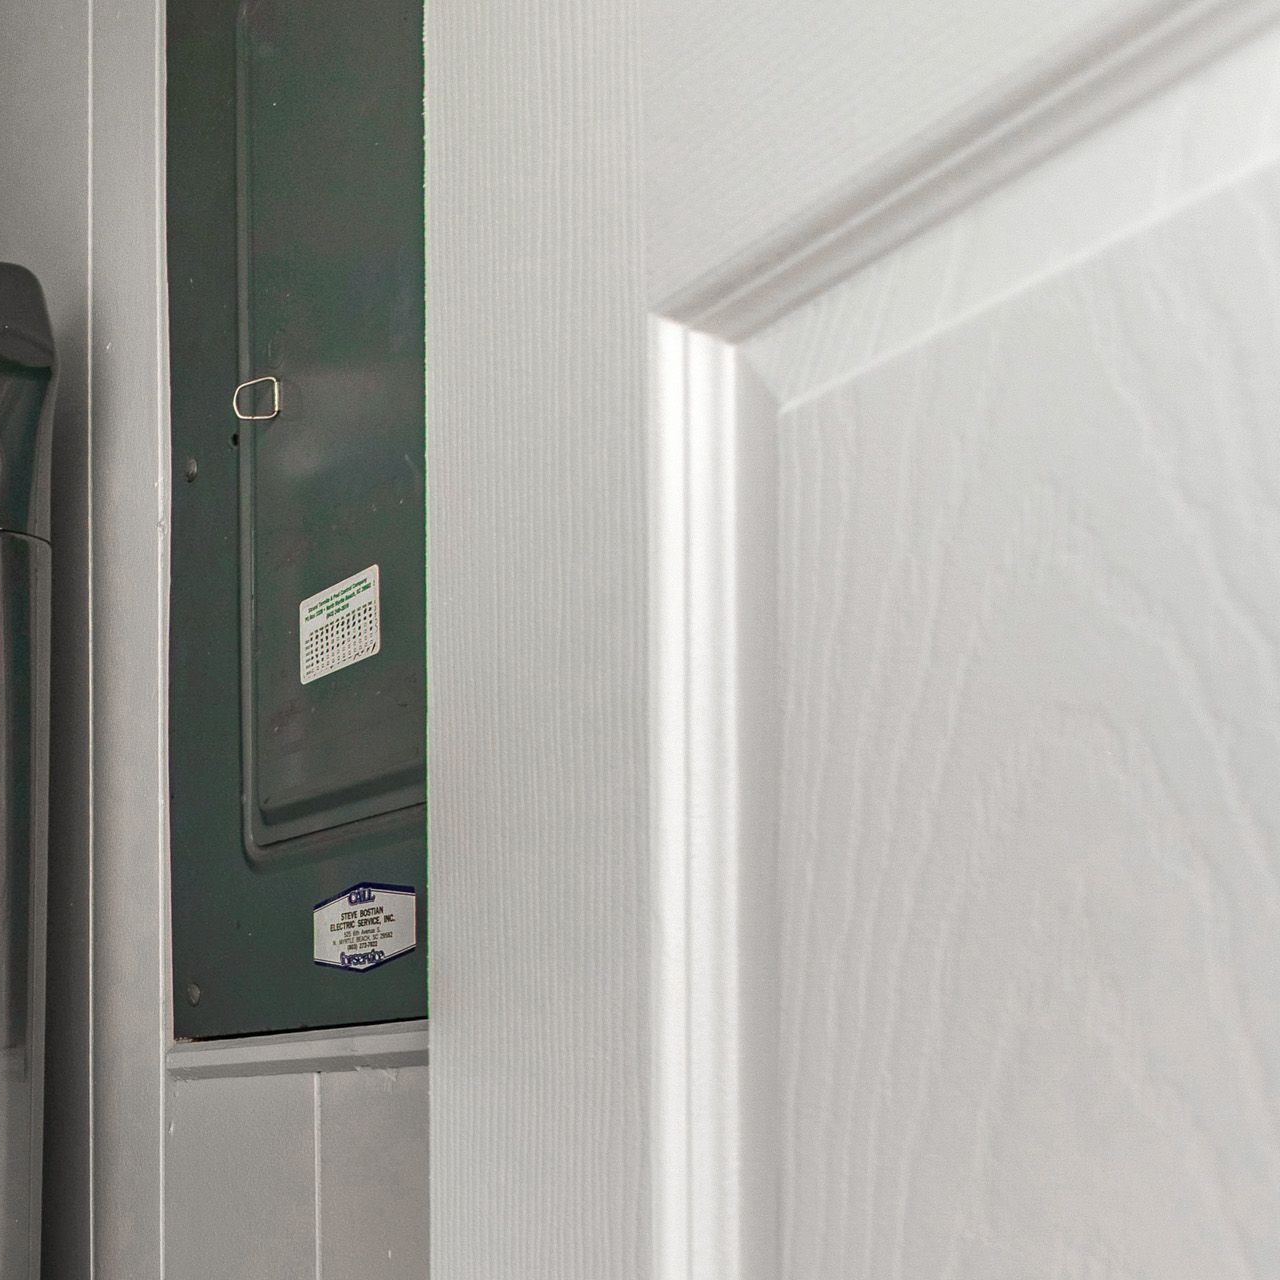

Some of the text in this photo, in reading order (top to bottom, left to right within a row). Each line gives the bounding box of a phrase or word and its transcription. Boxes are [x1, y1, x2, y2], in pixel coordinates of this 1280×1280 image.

[348, 888, 375, 906] CALL
[341, 906, 384, 920] STEVE BOSTIAN
[330, 920, 355, 932] ELECTRIC
[384, 914, 396, 922] INC.
